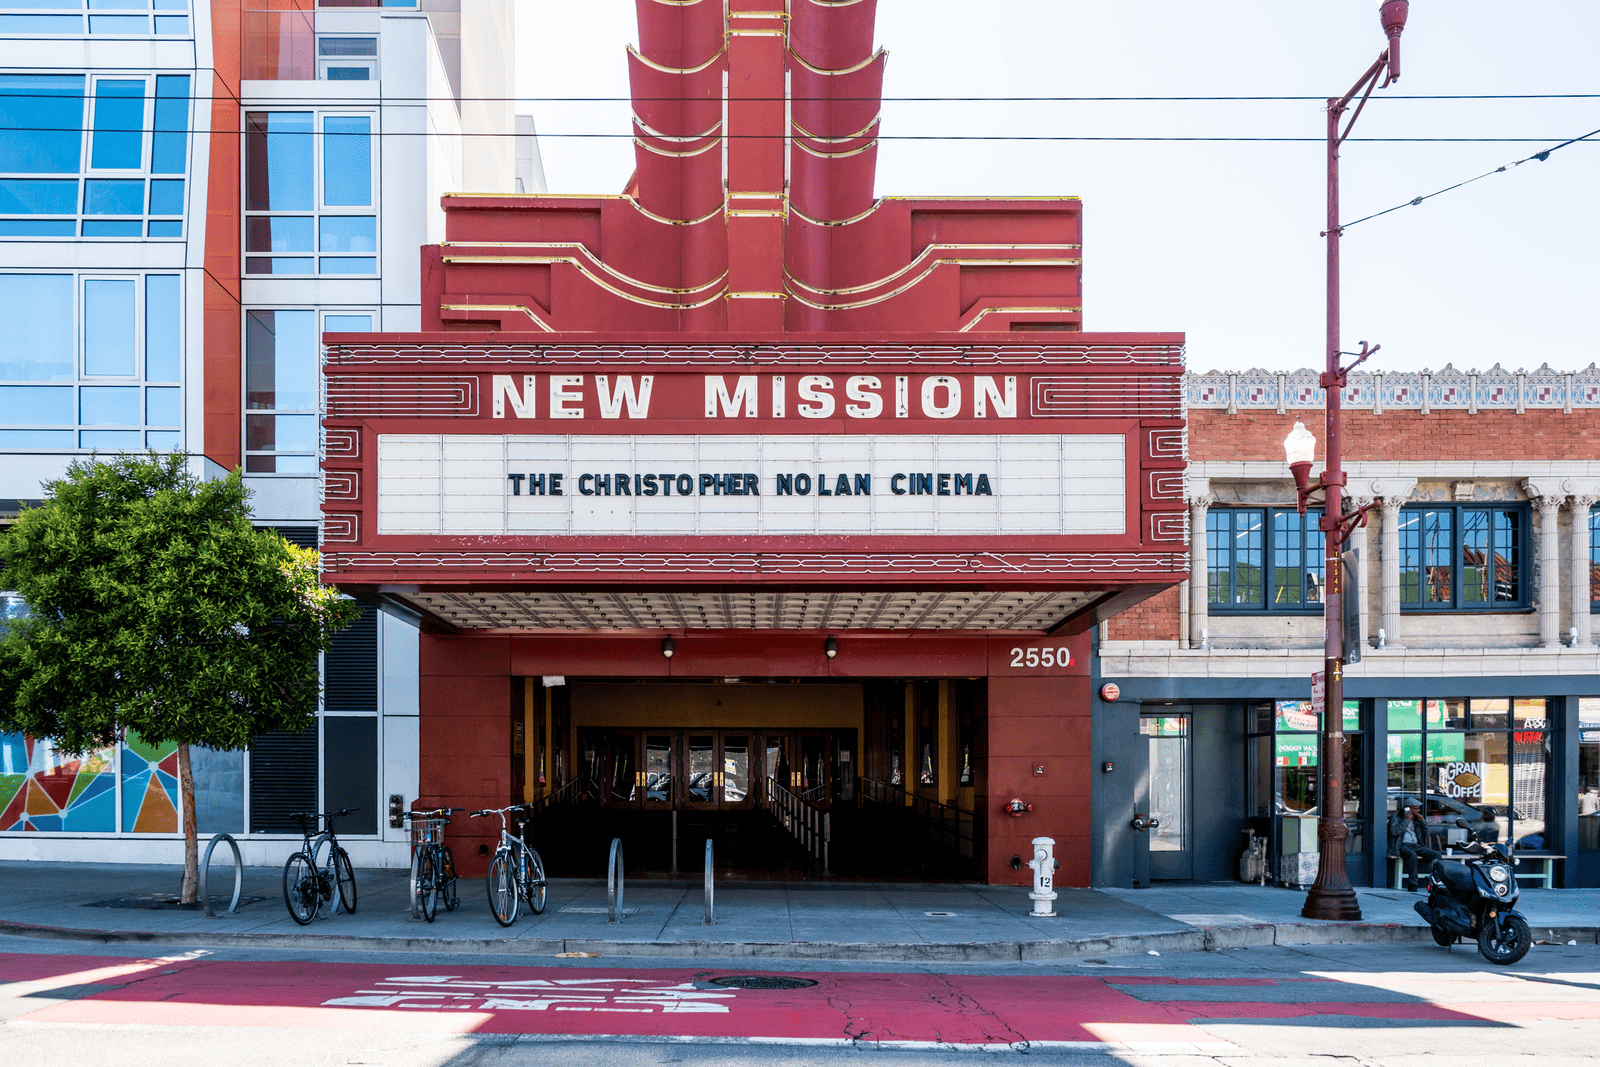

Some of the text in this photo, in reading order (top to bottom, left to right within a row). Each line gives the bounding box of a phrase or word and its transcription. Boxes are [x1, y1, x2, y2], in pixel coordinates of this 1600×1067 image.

[492, 374, 1017, 420] NEW MISSION
[507, 473, 993, 497] THE CHRISTOPHER NOLAN CINEMA
[1010, 647, 1070, 668] 2550
[1446, 780, 1484, 798] COFFE
[1040, 876, 1051, 888] 12
